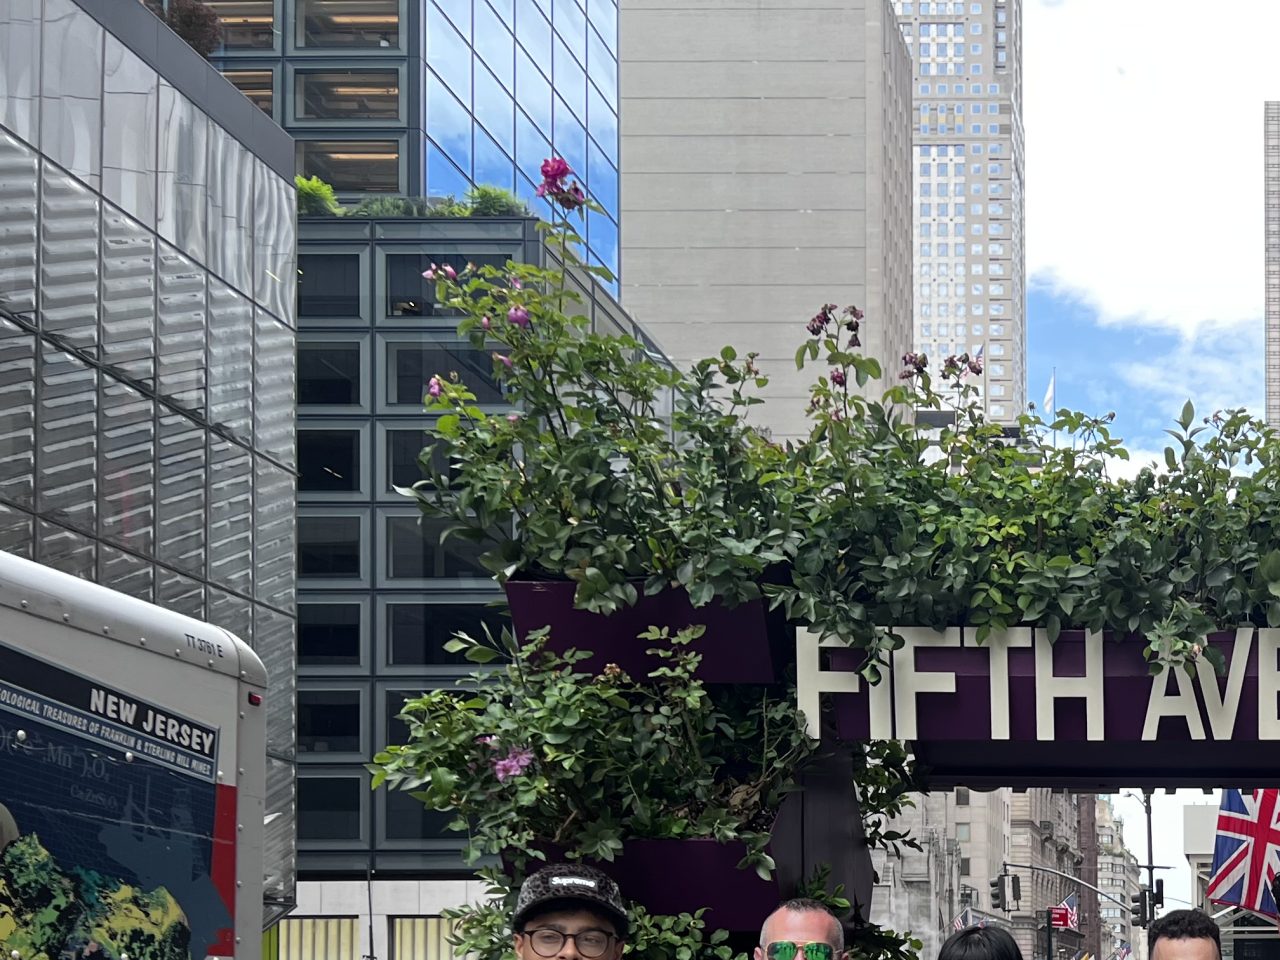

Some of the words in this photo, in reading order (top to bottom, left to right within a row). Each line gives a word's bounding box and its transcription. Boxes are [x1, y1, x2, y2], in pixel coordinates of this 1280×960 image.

[795, 626, 1105, 741] FIFTH
[0, 687, 40, 714] OLOGICAL
[43, 704, 88, 731] TREASURES
[88, 721, 100, 735] OF
[100, 725, 136, 748] FRANKLIN
[90, 688, 137, 725] NEW
[142, 709, 214, 754] JERSEY
